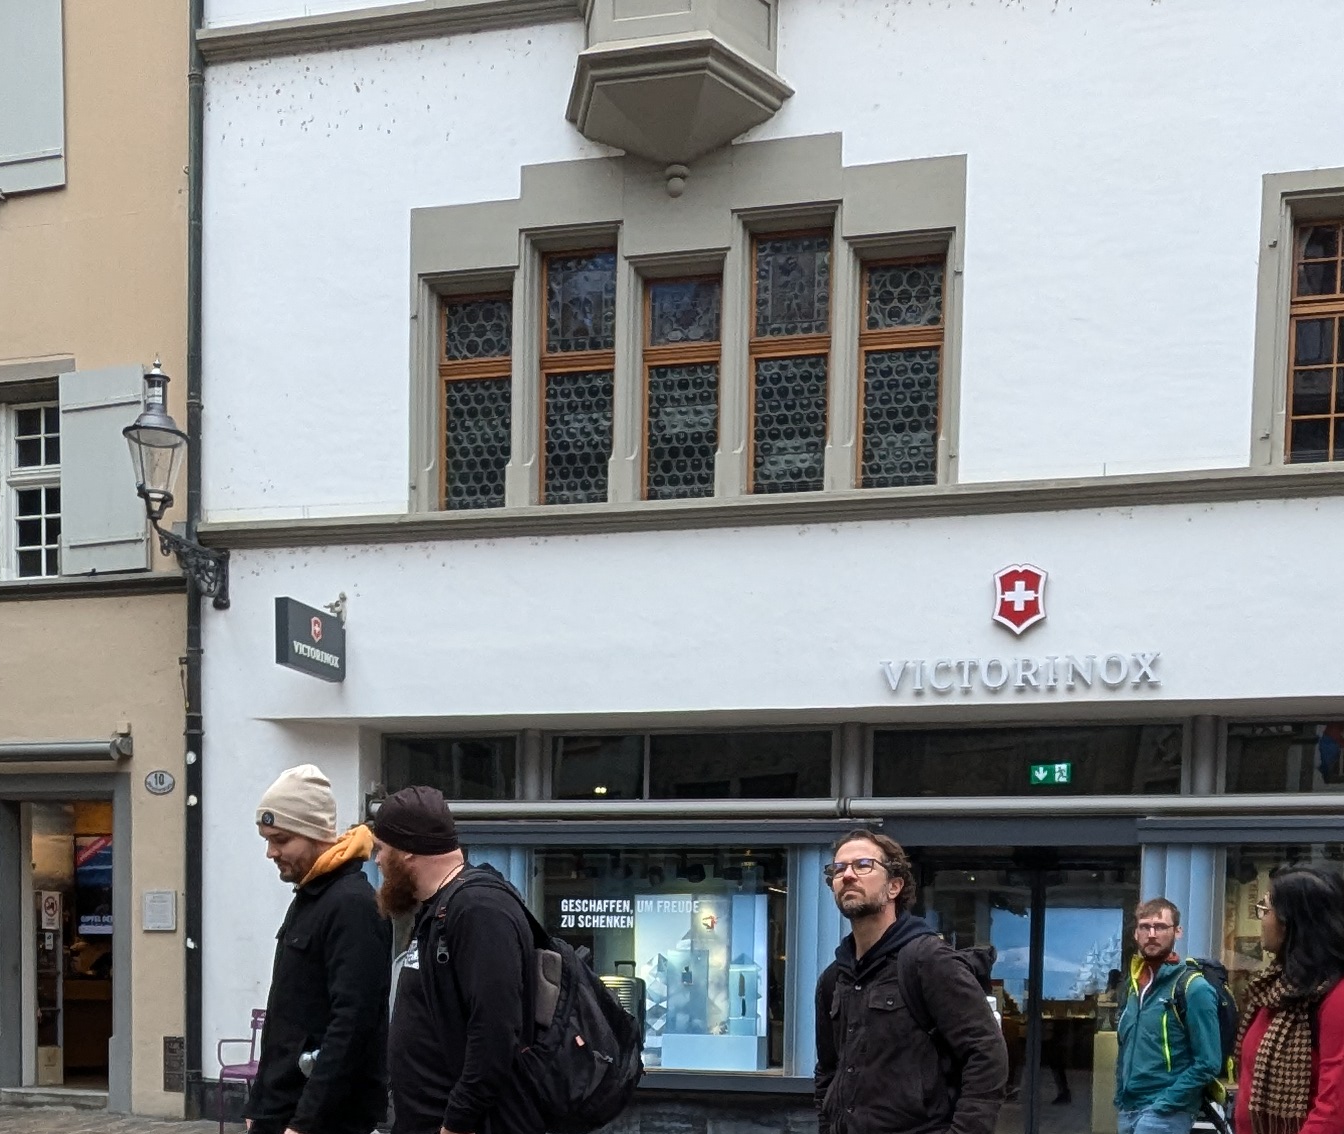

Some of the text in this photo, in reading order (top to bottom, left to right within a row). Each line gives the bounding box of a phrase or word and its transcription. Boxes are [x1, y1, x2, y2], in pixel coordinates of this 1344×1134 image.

[293, 640, 340, 669] VICTORINOX
[879, 651, 1163, 692] VICTORINOX
[154, 773, 165, 786] 10
[560, 899, 699, 915] GESCHAFFEN, UM FREUDE
[560, 914, 634, 928] ZU SCHENKEN
